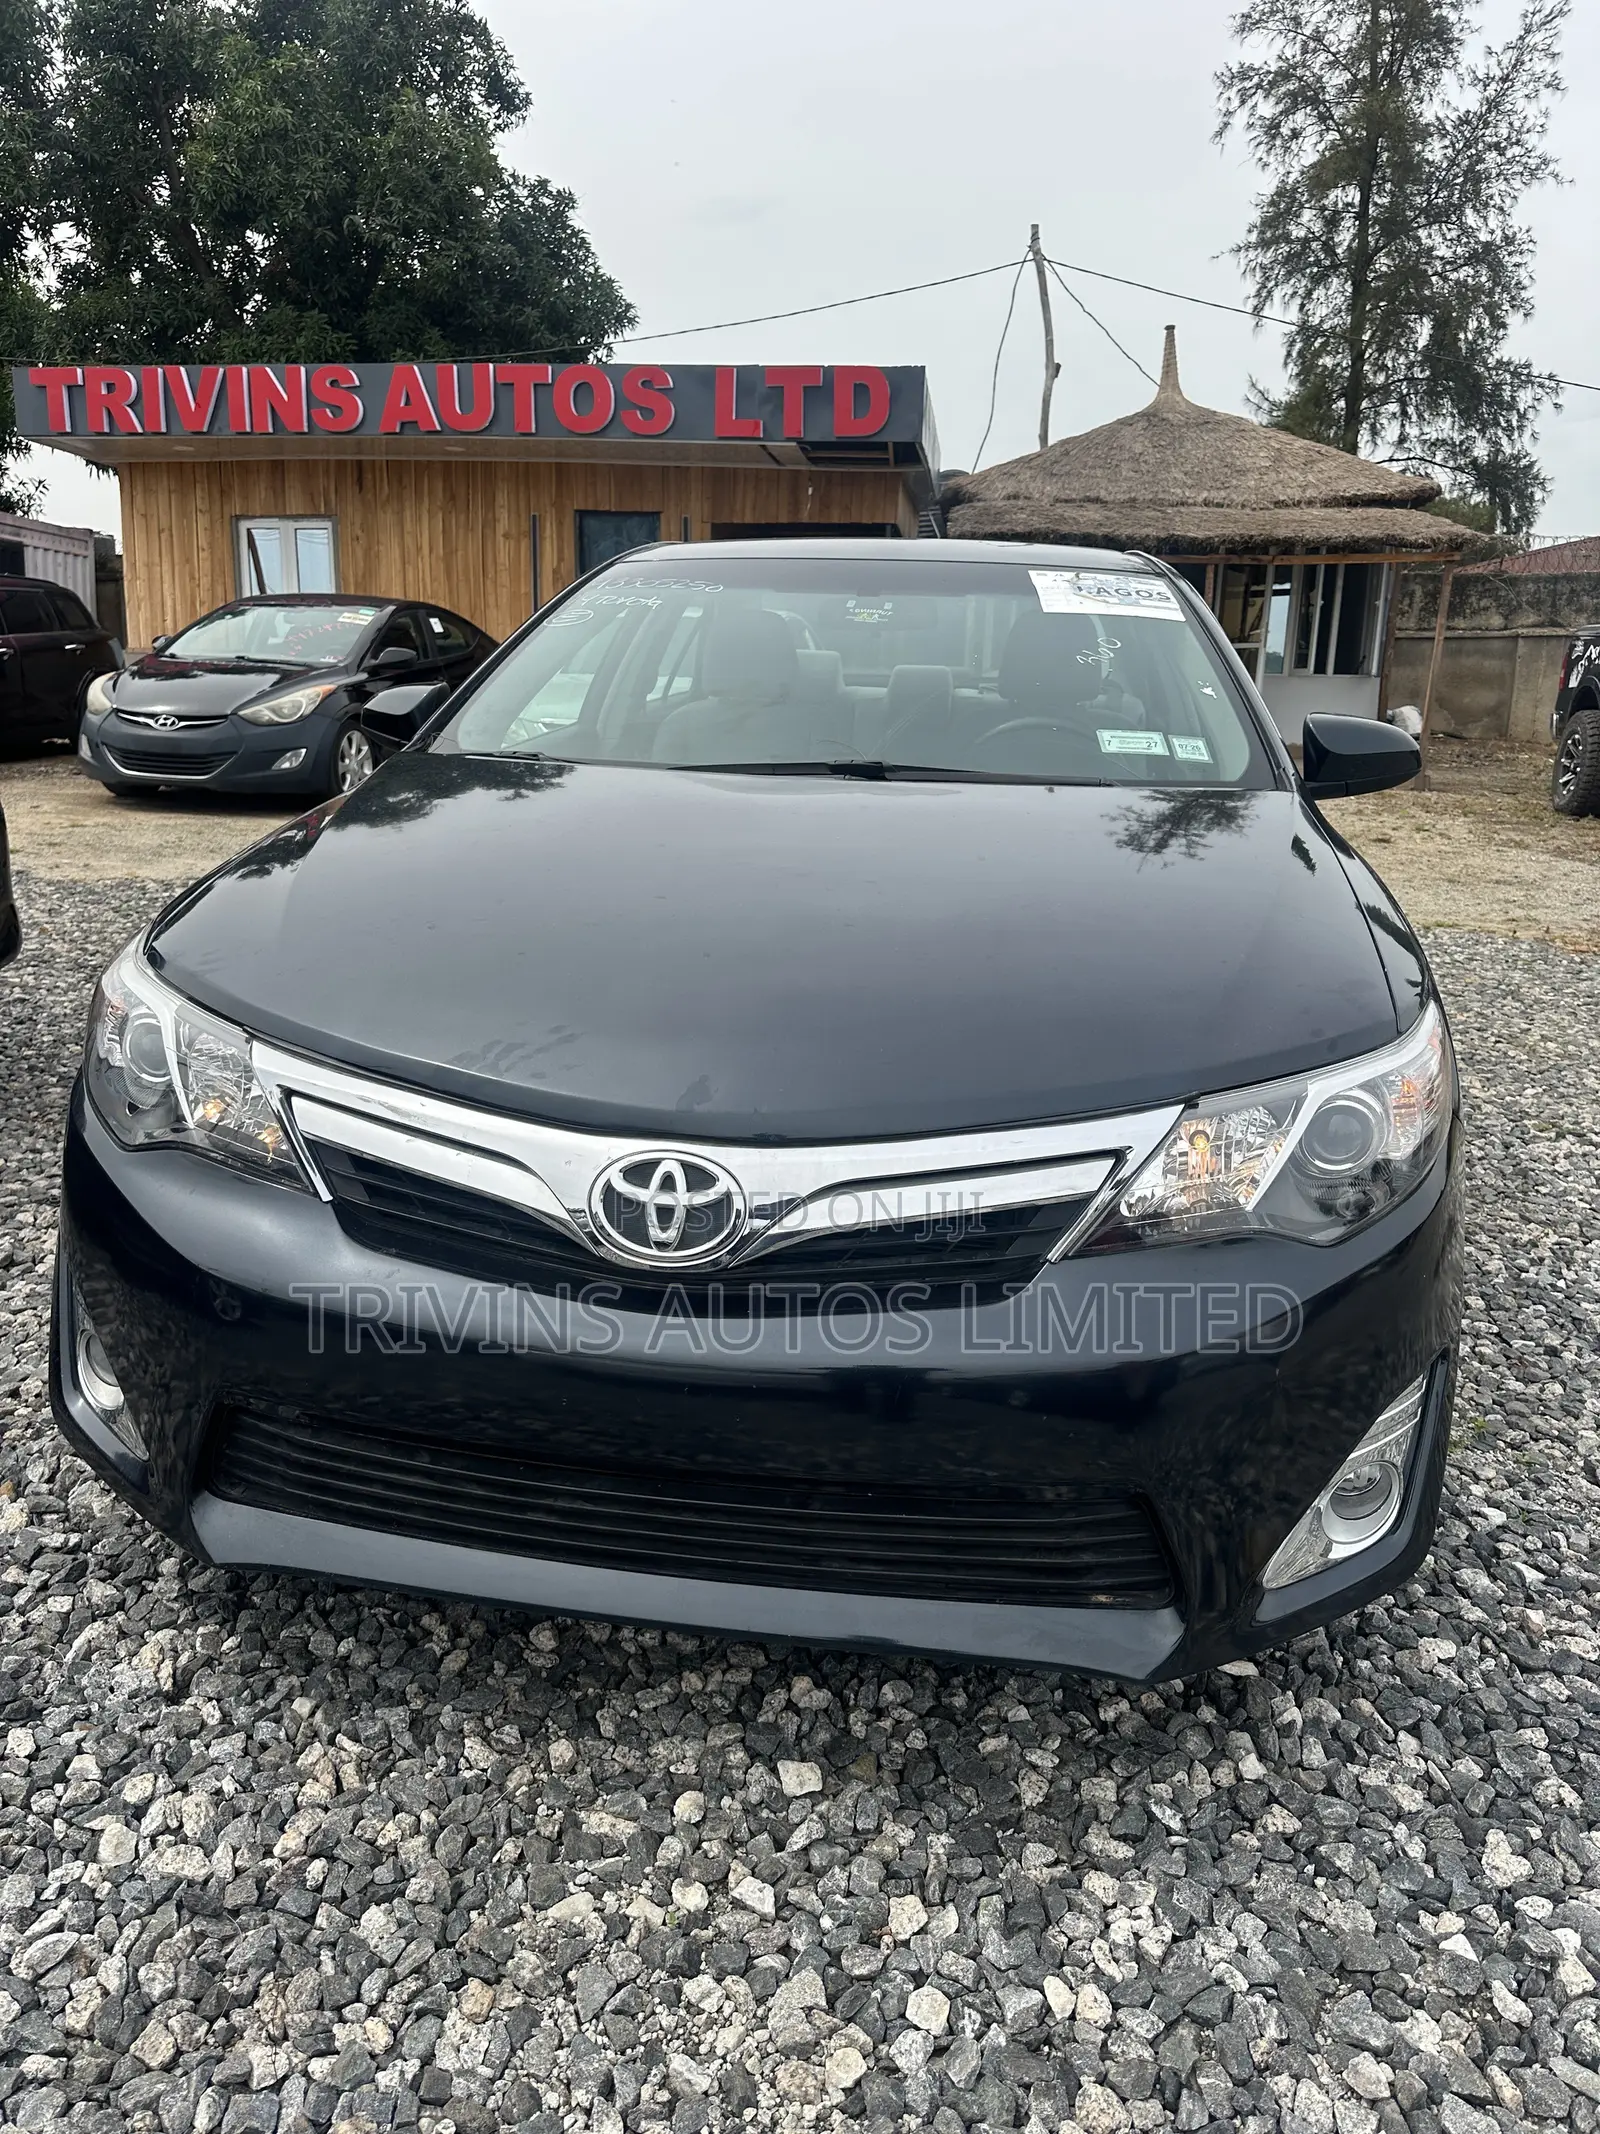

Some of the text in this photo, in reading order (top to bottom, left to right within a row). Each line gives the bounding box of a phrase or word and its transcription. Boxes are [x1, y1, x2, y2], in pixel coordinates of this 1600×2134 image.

[29, 363, 890, 438] TRIVINS AUTOS LTD
